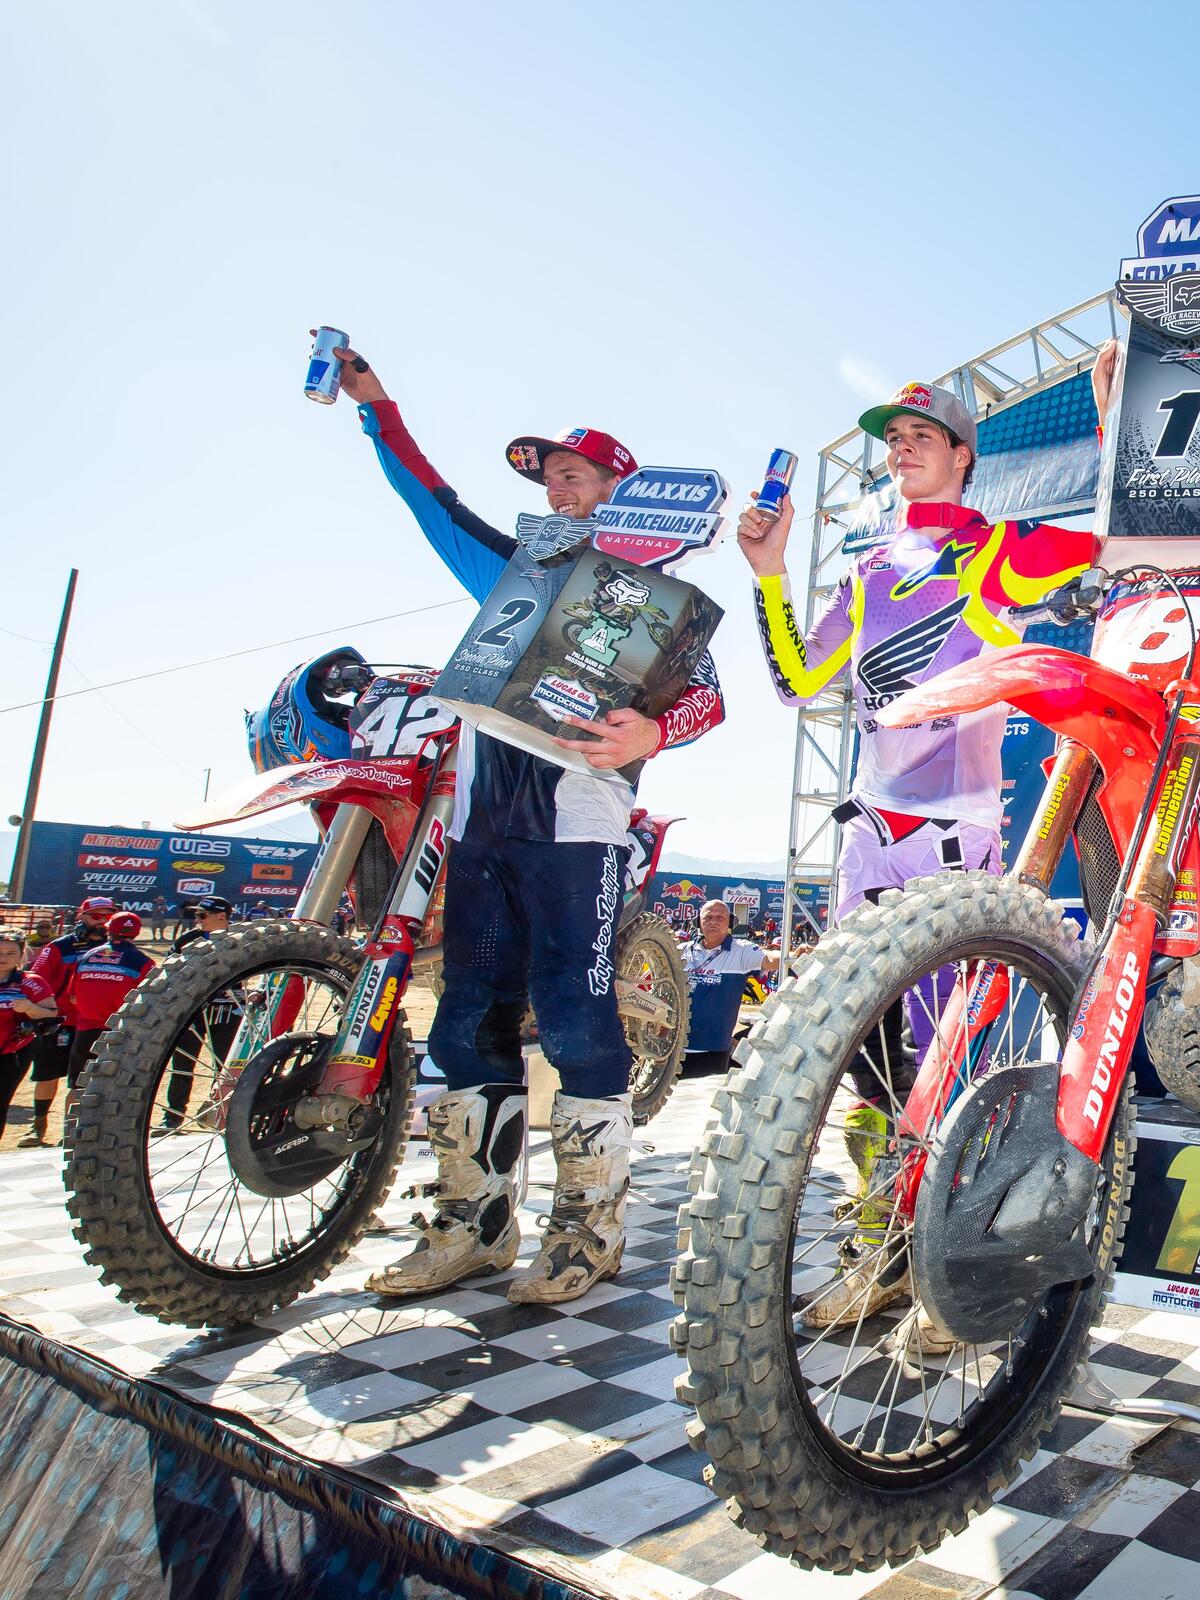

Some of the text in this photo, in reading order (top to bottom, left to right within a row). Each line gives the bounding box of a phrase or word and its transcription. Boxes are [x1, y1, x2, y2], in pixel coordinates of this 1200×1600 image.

[1126, 467, 1168, 488] First
[624, 480, 712, 502] MAXXIS
[1129, 490, 1158, 499] 250
[598, 509, 621, 527] FOX
[627, 510, 692, 532] RACEWAY
[603, 535, 672, 550] NATIONAL
[1175, 576, 1200, 586] OIL
[474, 598, 538, 648] 2
[454, 663, 500, 678] 250 CLASS
[366, 686, 407, 696] LUCAS OIL
[551, 679, 579, 696] LUCAS
[354, 695, 458, 757] 42
[1038, 774, 1071, 840] Factory
[1154, 756, 1194, 857] Connection
[169, 838, 231, 857] WPS
[80, 872, 157, 885] SPECIALIZED
[260, 867, 286, 876] KTM
[243, 886, 298, 895] GASGAS
[654, 902, 683, 920] Red
[81, 973, 125, 981] GASGAS
[350, 965, 383, 1039] DUNLOP
[1083, 952, 1141, 1129] DUNLOP
[1167, 1284, 1200, 1297] LUCAS OIL
